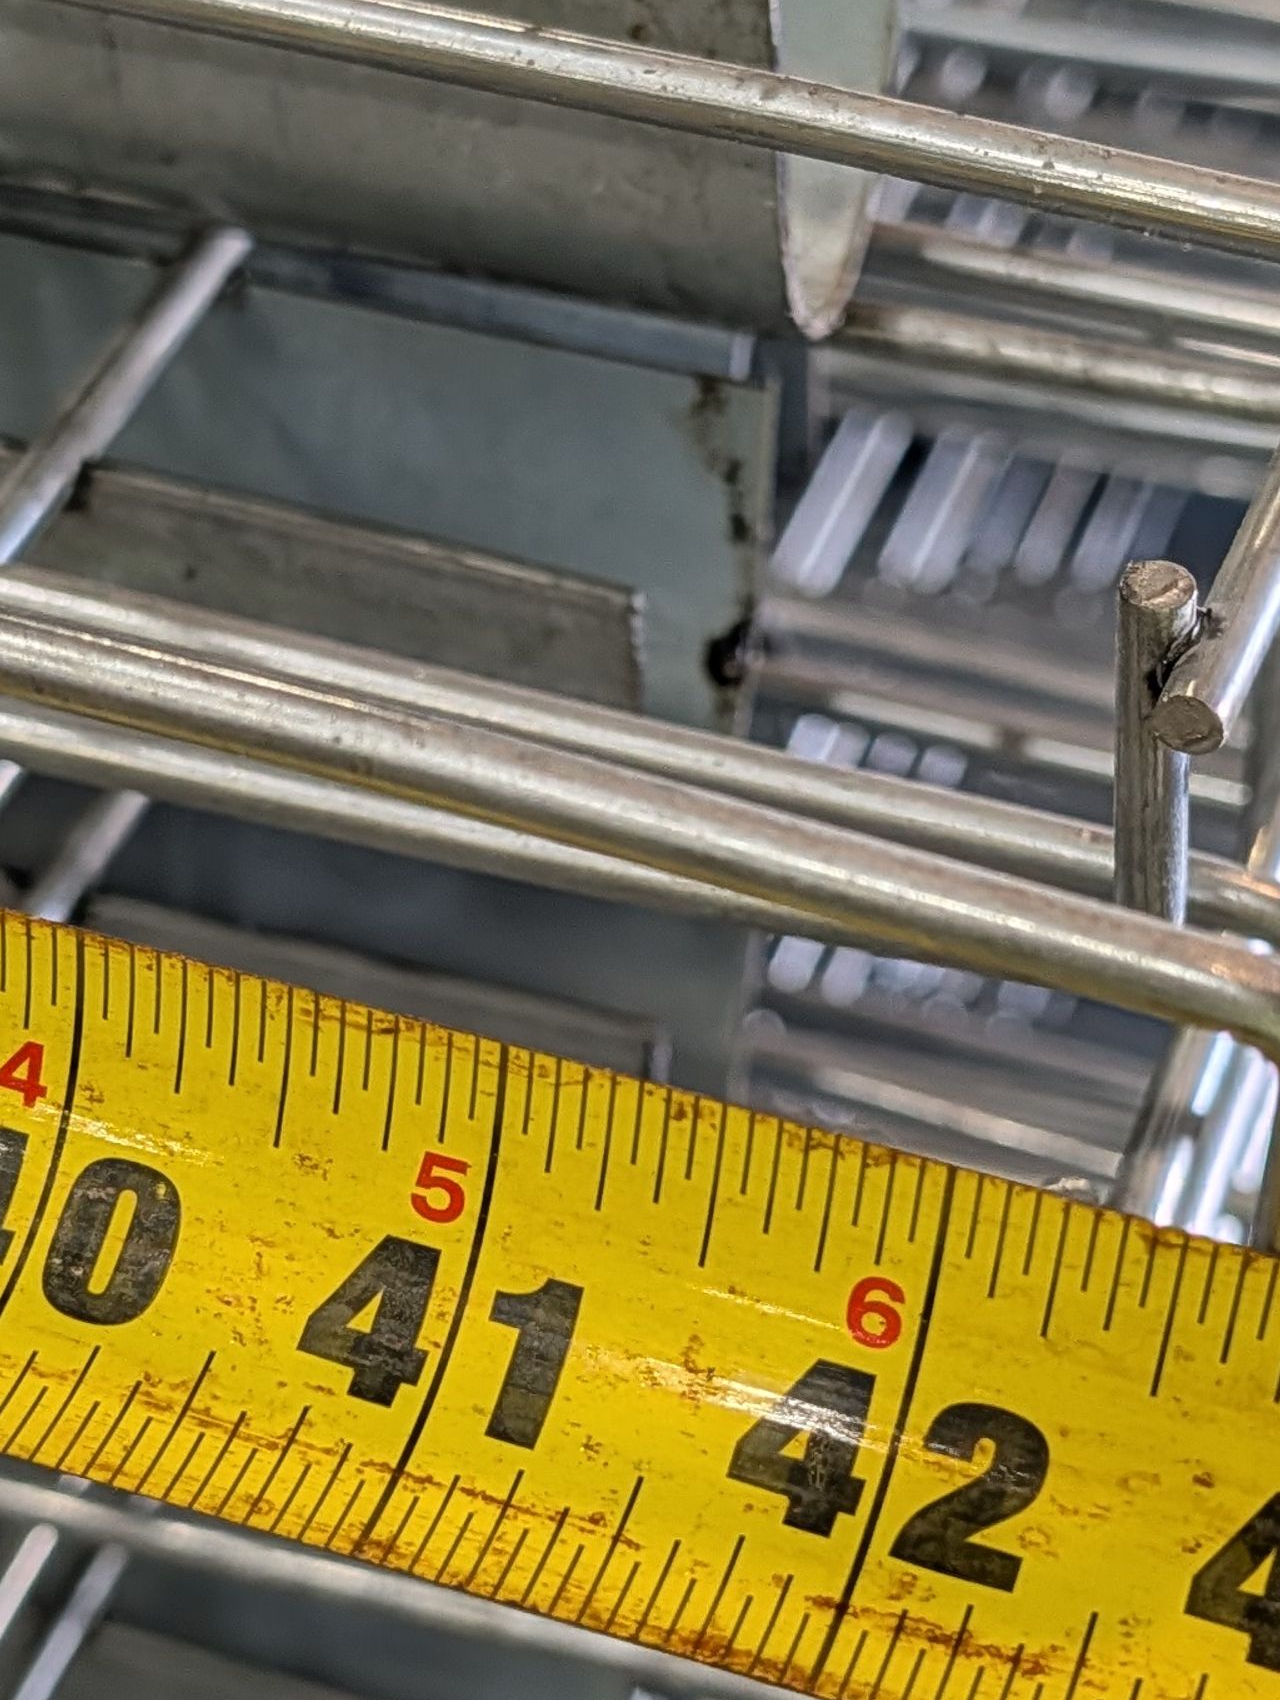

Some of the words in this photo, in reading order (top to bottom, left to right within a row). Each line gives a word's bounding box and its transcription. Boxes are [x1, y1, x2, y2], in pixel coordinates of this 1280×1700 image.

[410, 1152, 471, 1223] 5
[845, 1276, 906, 1348] 6
[296, 1235, 584, 1449] 41
[727, 1359, 1051, 1593] 42
